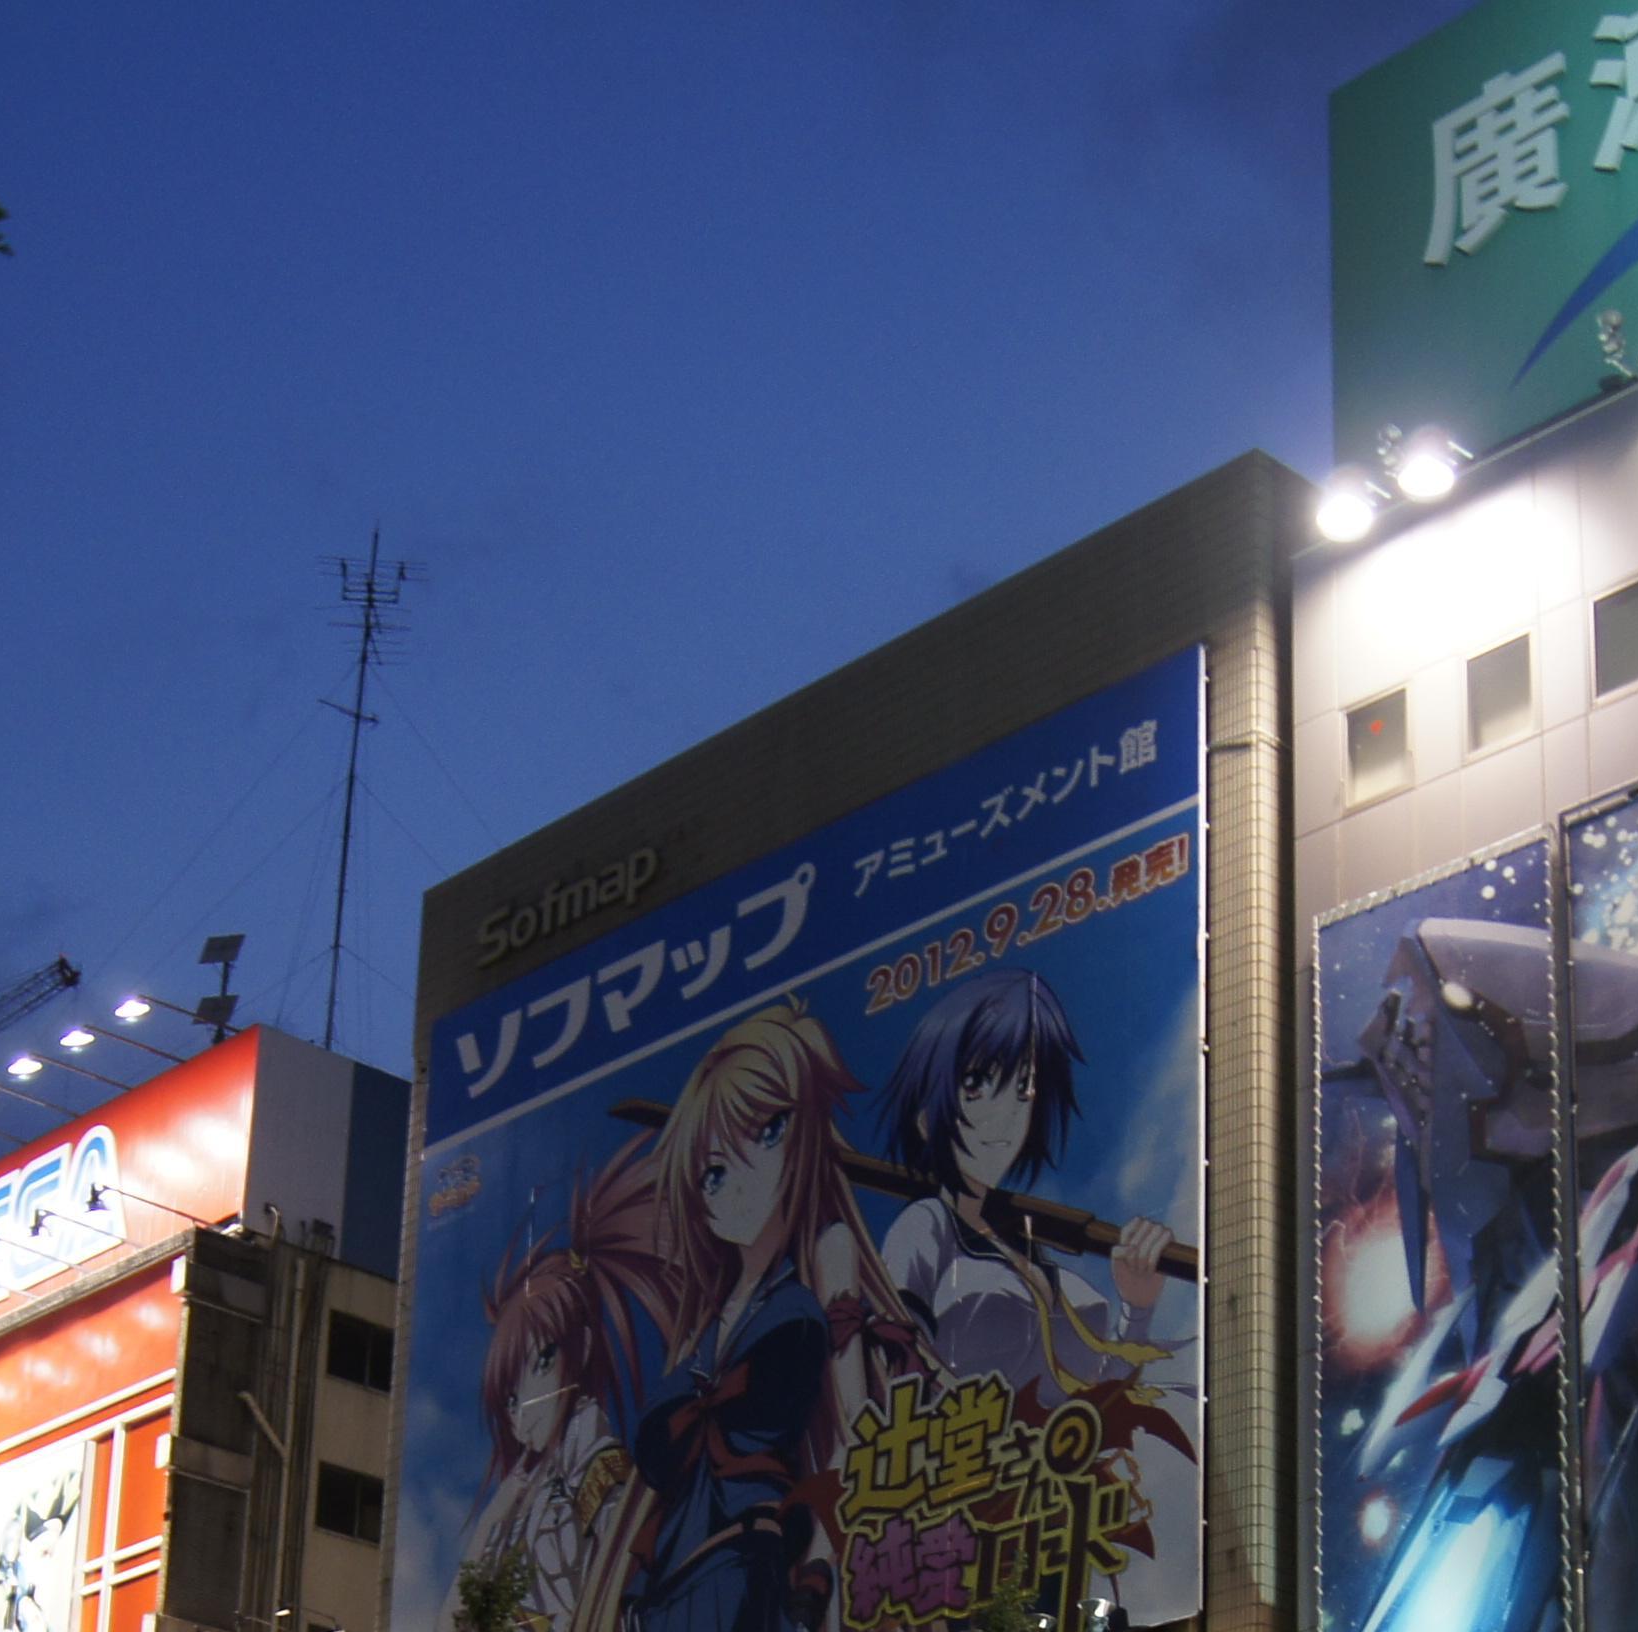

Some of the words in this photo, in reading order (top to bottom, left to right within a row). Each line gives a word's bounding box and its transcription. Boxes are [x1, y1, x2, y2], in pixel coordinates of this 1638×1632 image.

[853, 718, 1158, 897] アミューズメント館
[457, 862, 816, 1099] ソフマップ
[476, 845, 657, 968] Sofmap
